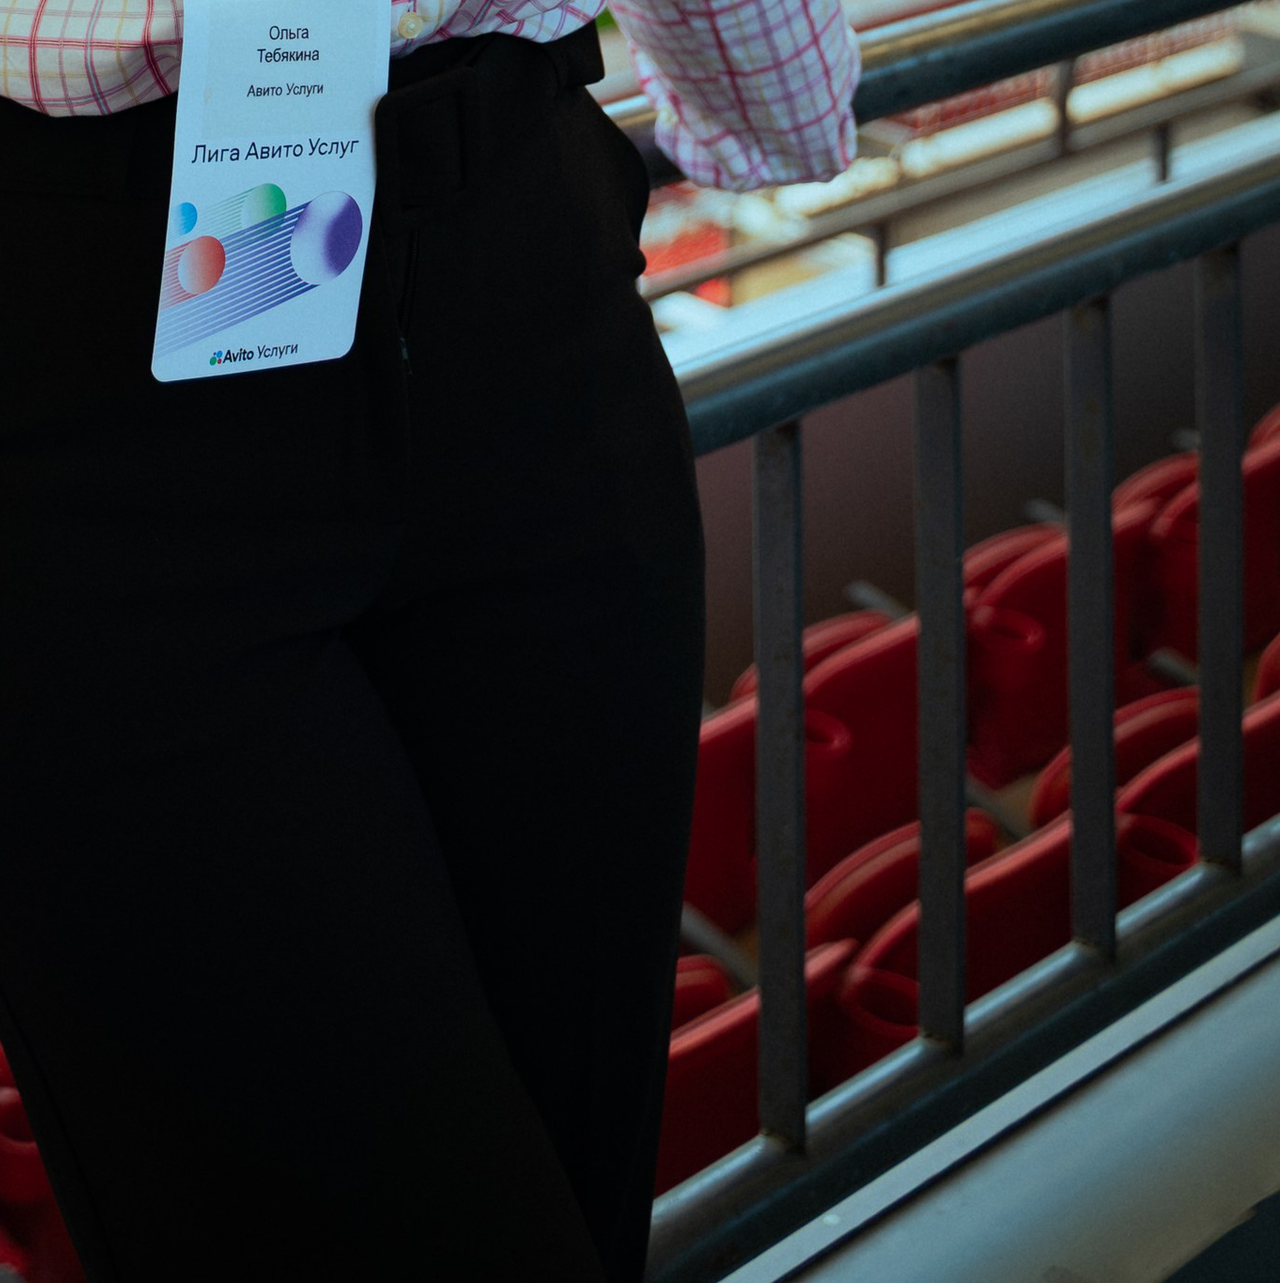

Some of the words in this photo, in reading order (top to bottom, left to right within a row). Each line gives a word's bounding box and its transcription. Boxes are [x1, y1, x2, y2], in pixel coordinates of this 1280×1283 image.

[269, 25, 309, 41] Ольга
[257, 47, 320, 63] Тебякина
[246, 84, 283, 97] Авито
[286, 82, 324, 98] Услуги
[191, 144, 240, 164] Лига
[245, 141, 303, 161] Авито
[308, 137, 360, 159] Услуг
[222, 347, 254, 364] Avito
[257, 343, 298, 359] Услуги
